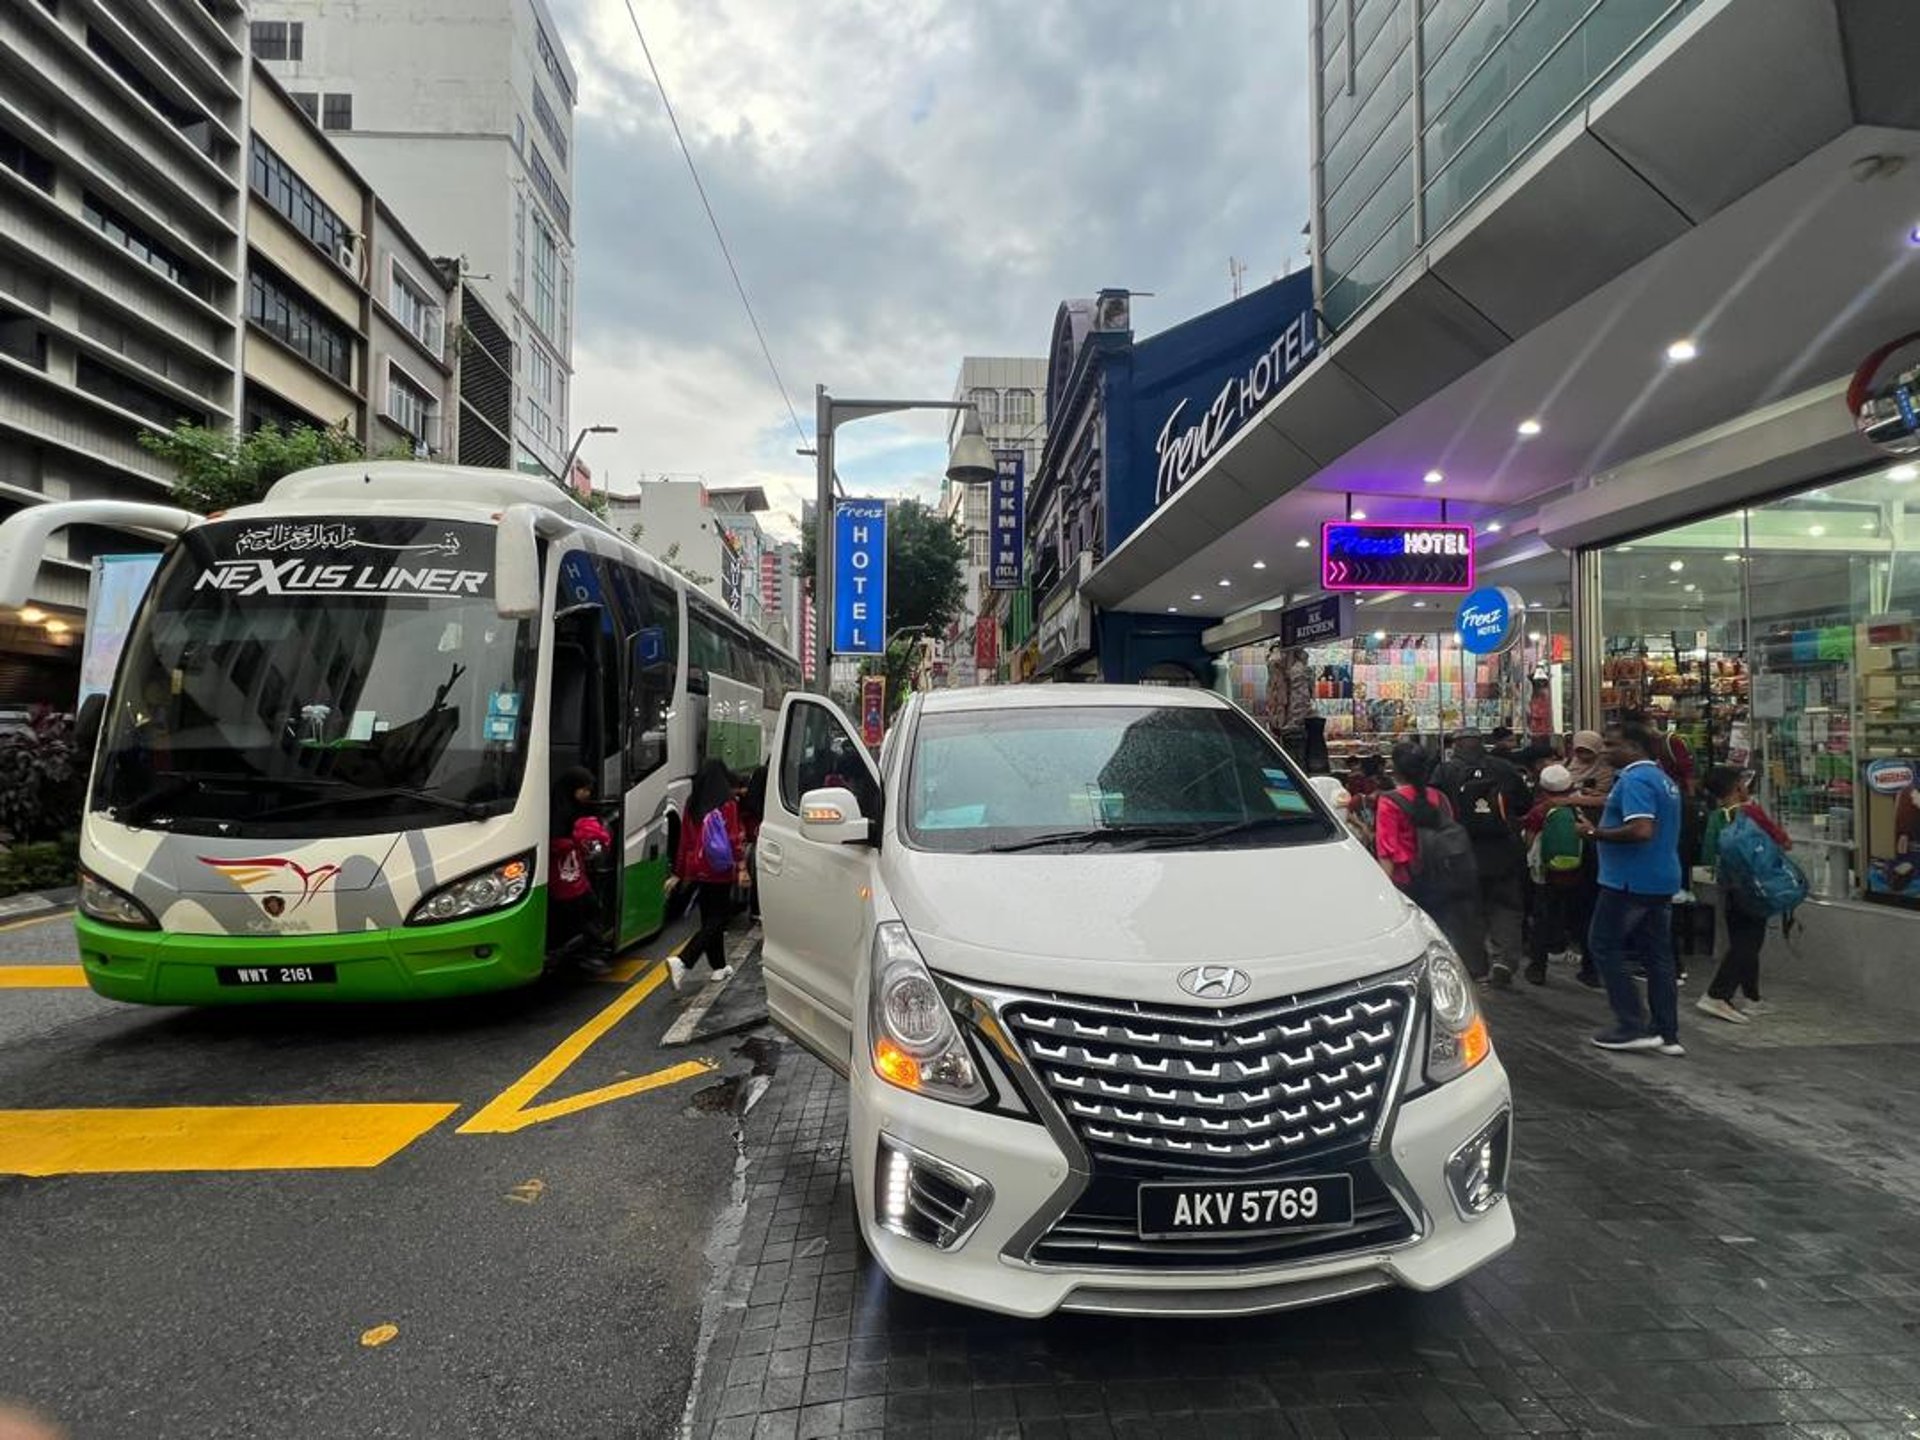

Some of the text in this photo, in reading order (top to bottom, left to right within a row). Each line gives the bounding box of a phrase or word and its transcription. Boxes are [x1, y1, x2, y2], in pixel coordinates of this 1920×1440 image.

[1155, 312, 1315, 505] Frenz HOTEL
[835, 502, 884, 518] Frenz
[998, 461, 1017, 564] MUKMIN
[1403, 532, 1470, 555] HOTEL
[354, 565, 488, 593] LINER
[851, 526, 869, 646] HOTEL
[1462, 606, 1502, 630] Frenz
[1477, 624, 1502, 637] HOTEL
[237, 967, 314, 983] WWT 2161
[1173, 1187, 1319, 1226] AKV 5769
